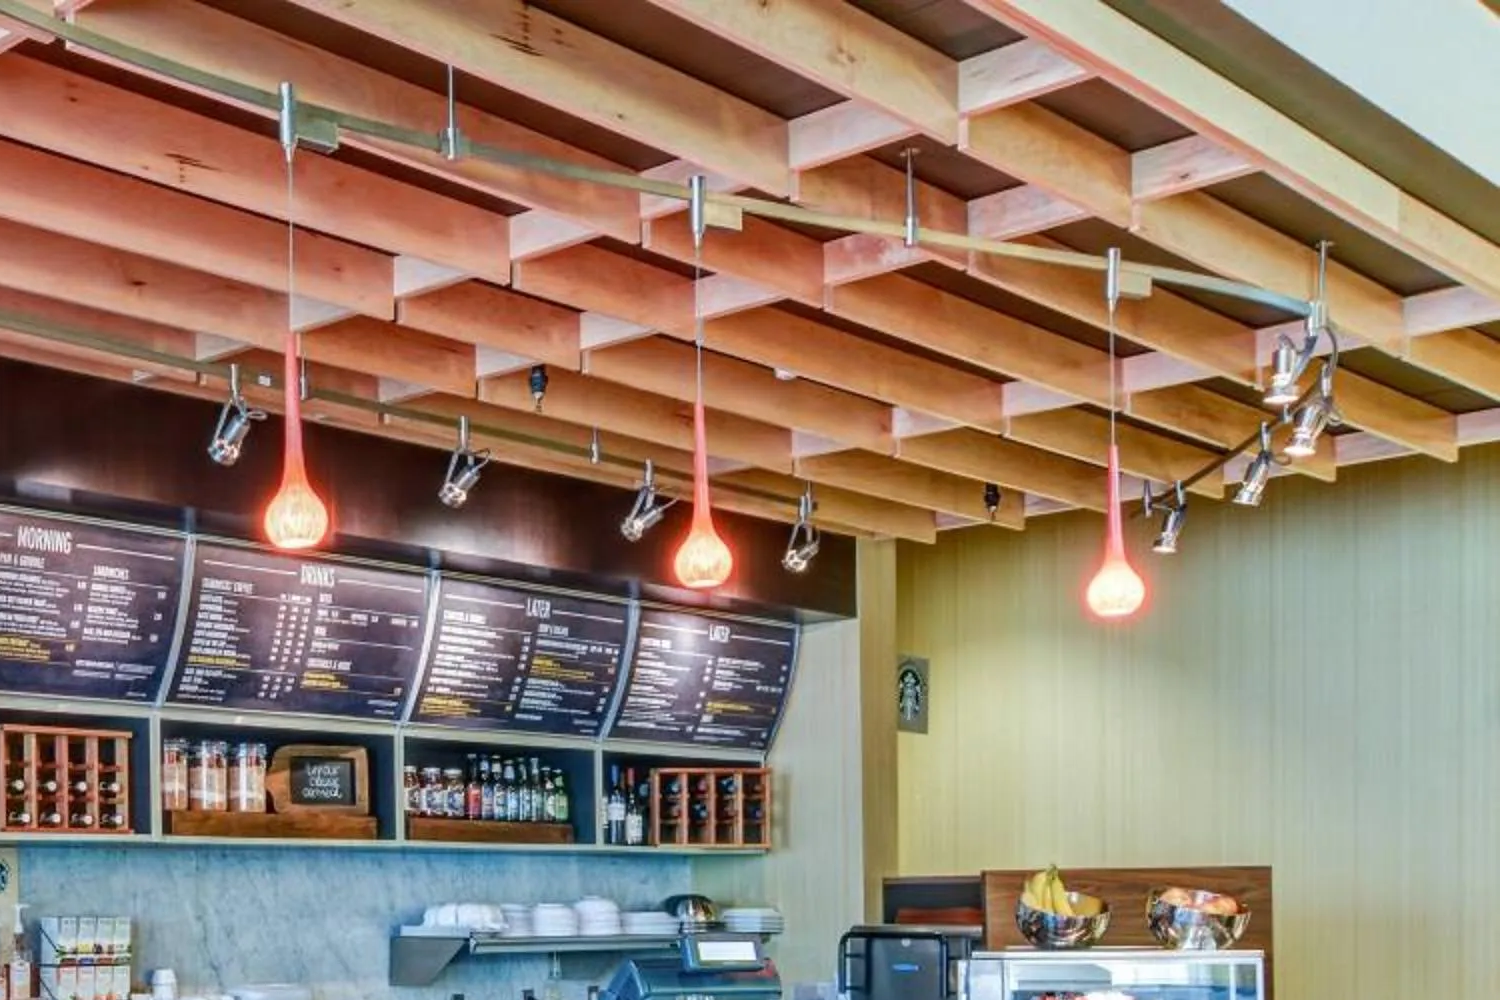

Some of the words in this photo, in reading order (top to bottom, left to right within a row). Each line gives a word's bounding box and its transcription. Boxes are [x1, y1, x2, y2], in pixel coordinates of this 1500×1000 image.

[17, 525, 73, 554] MORNING
[301, 563, 335, 588] DRINKS
[525, 596, 551, 619] LATER
[709, 623, 731, 643] LATER
